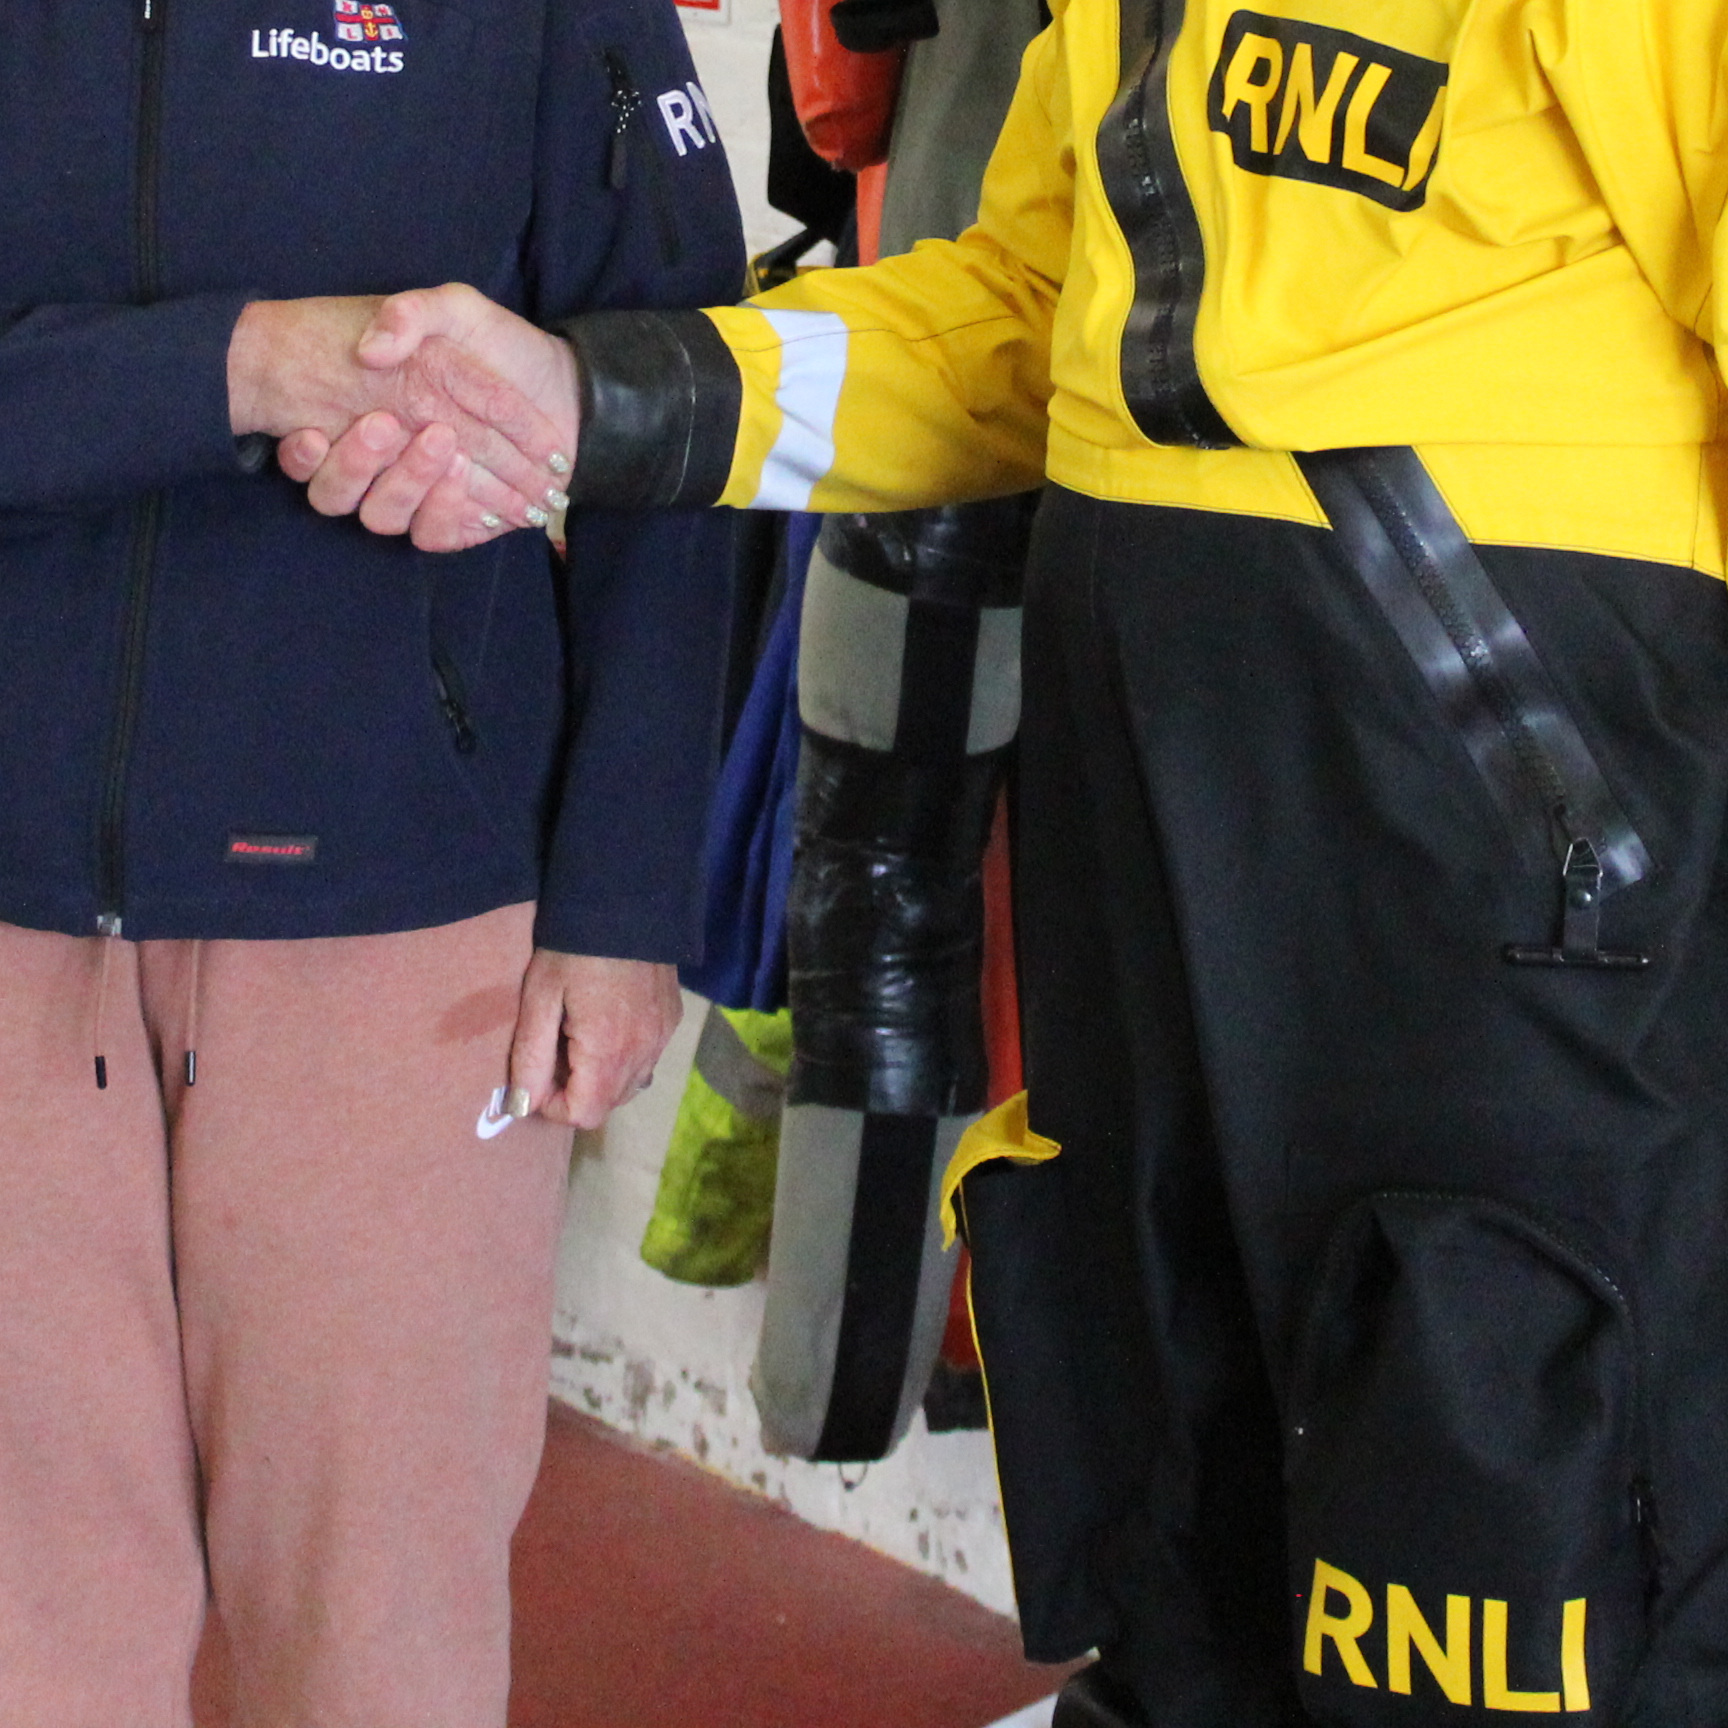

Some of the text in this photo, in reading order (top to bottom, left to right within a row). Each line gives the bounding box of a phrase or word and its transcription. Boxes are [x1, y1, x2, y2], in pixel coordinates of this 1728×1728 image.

[251, 28, 405, 73] Lifeboats
[1222, 32, 1448, 192] RNLI
[1303, 1558, 1591, 1713] RNLI
